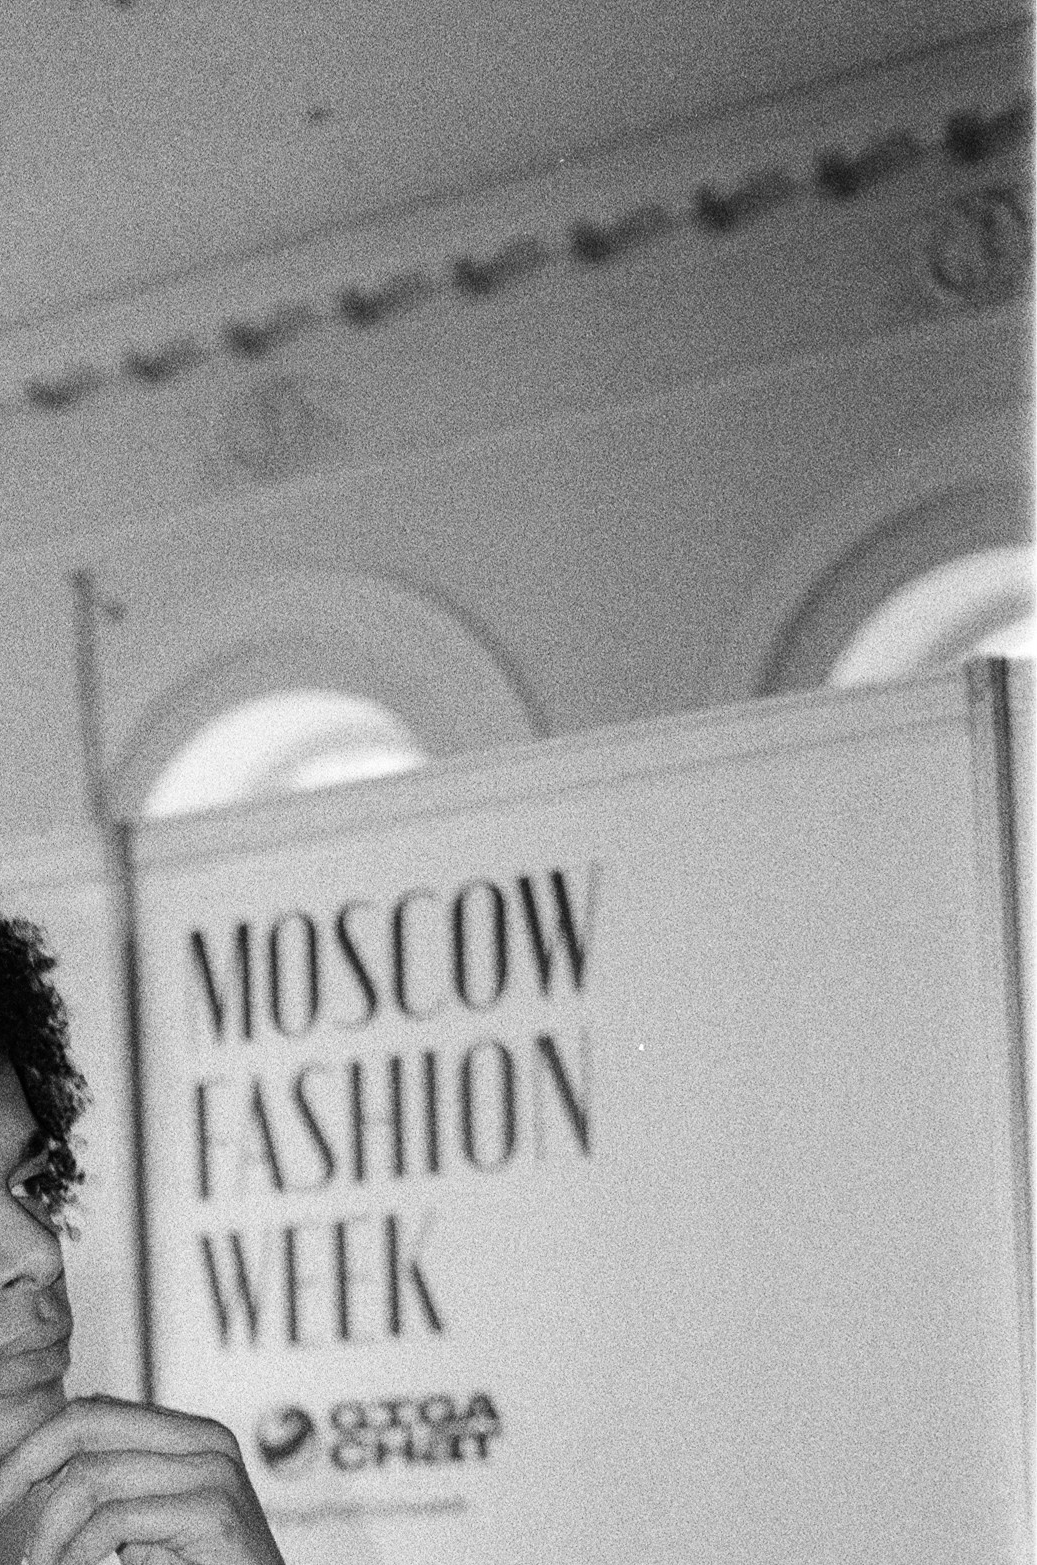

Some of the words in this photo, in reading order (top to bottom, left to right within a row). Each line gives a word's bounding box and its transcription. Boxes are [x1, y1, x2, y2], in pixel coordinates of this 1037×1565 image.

[188, 862, 602, 1042] MOSCOW
[194, 1026, 592, 1202] FASHION
[196, 1208, 446, 1348] WEEK
